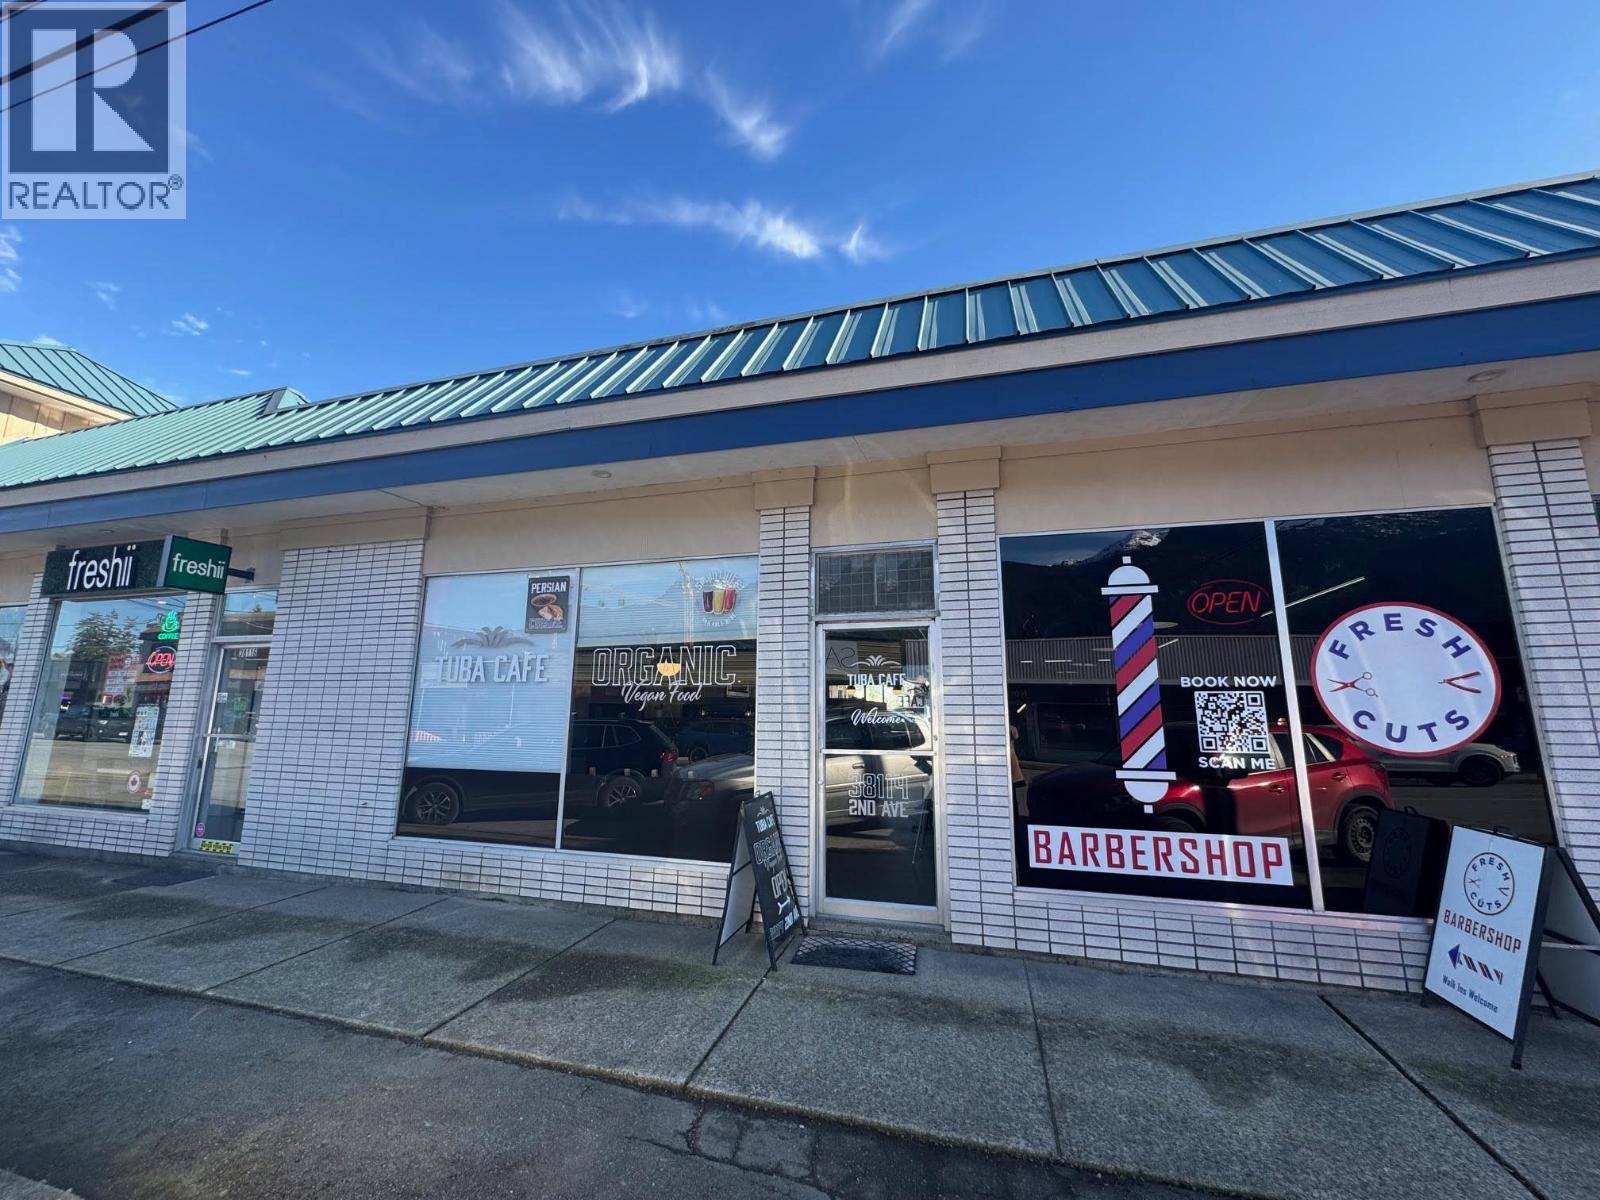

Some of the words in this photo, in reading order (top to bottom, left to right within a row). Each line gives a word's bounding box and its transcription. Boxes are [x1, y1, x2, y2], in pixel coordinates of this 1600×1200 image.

[66, 544, 137, 592] freshii
[172, 552, 226, 580] freshii
[530, 580, 567, 594] PERSIAN
[1190, 589, 1263, 615] OPEN
[1327, 611, 1473, 661] FRESH
[147, 651, 175, 667] OPEN
[435, 654, 486, 683] TUBA
[493, 653, 550, 683] CAFE
[591, 644, 738, 688] ORGANIC
[847, 673, 875, 686] TUBA
[878, 673, 906, 686] CAFE
[1180, 675, 1229, 688] BOOK
[1234, 674, 1278, 688] NOW
[620, 682, 666, 712] Vegan
[667, 680, 704, 704] Food
[850, 706, 904, 726] Welcome
[1351, 707, 1471, 745] CUTS
[1197, 755, 1246, 770] SCAN
[1250, 757, 1277, 770] ME
[847, 798, 876, 817] 2ND
[880, 801, 909, 818] AVE
[1032, 829, 1284, 880] BARBERSHOP
[1471, 856, 1511, 882] FRESH
[1470, 891, 1503, 911] CUTS
[1443, 908, 1522, 954] BARBERSHOP
[1442, 974, 1456, 990] Walk
[1468, 987, 1498, 1013] Welcome
